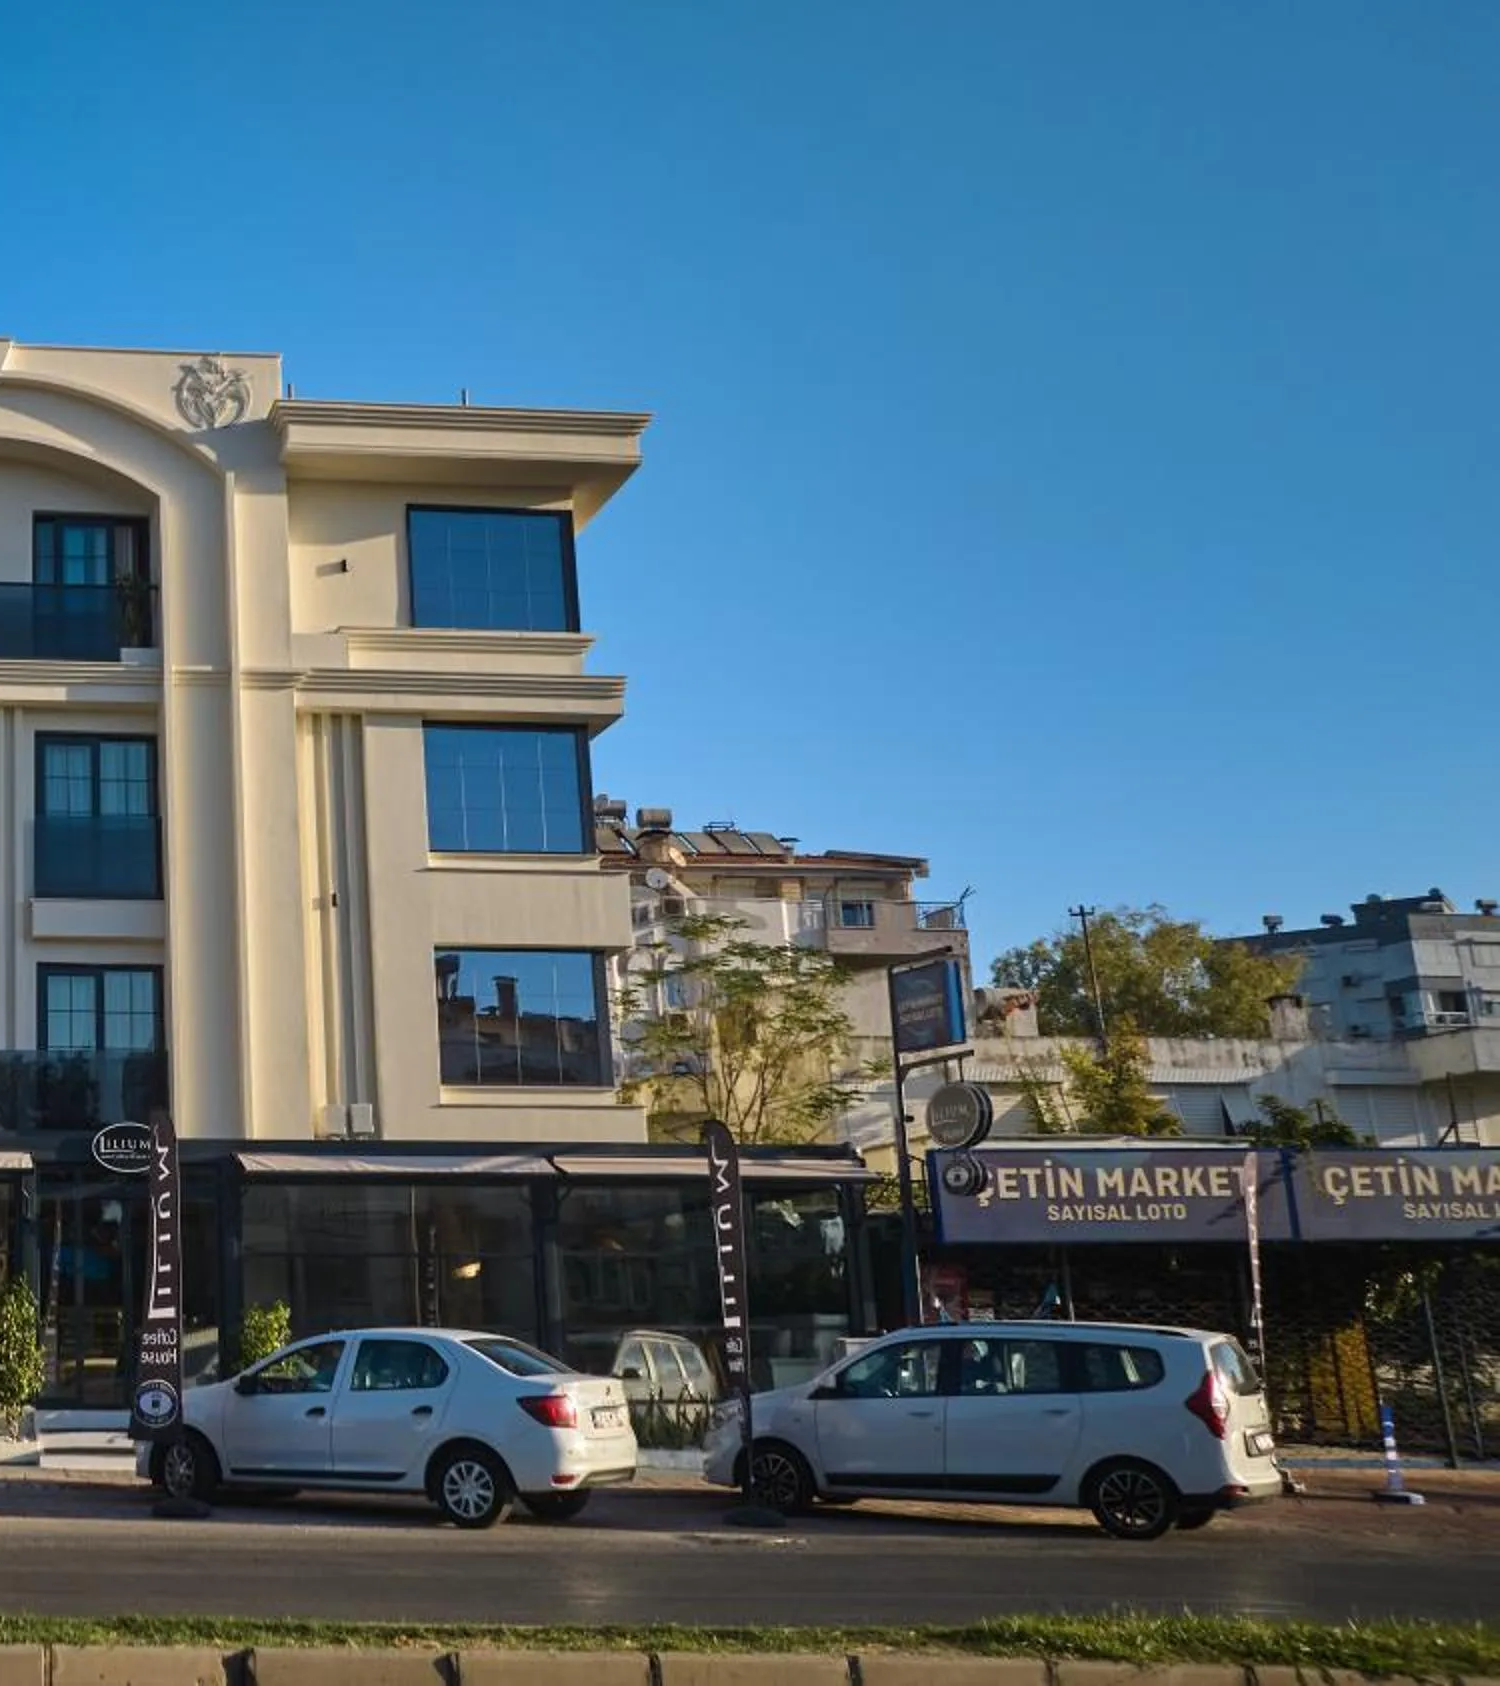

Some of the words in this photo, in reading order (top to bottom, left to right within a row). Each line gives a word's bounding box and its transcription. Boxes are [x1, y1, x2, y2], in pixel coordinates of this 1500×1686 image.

[100, 1136, 151, 1153] LILIUM
[1323, 1157, 1441, 1206] ÇETİN
[1047, 1203, 1132, 1221] SAYISAL
[1137, 1203, 1188, 1221] LOTO
[1403, 1201, 1490, 1220] SAYISAL
